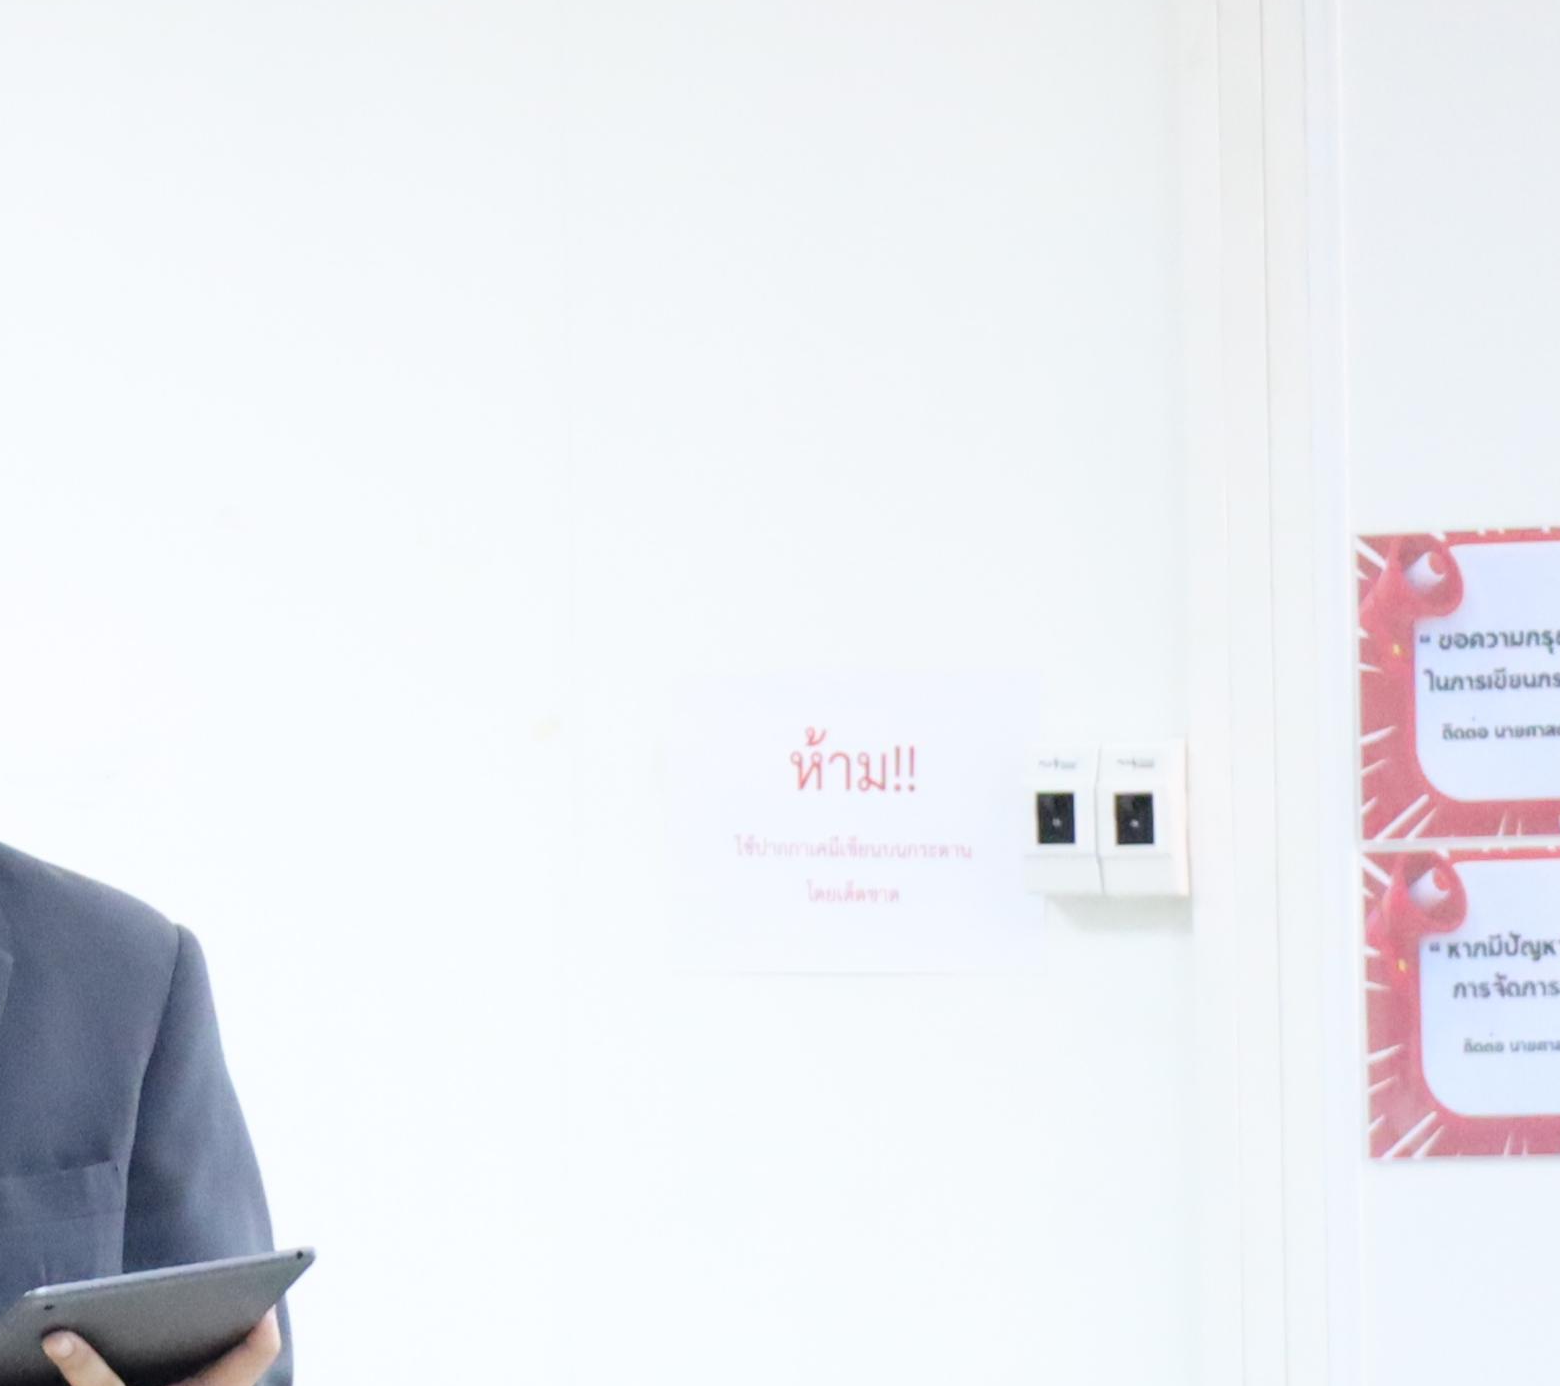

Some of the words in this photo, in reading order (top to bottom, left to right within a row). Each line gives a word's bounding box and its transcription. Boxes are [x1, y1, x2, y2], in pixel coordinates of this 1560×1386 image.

[1441, 715, 1489, 741] ติดต่อ
[789, 726, 917, 793] ห้าม!!
